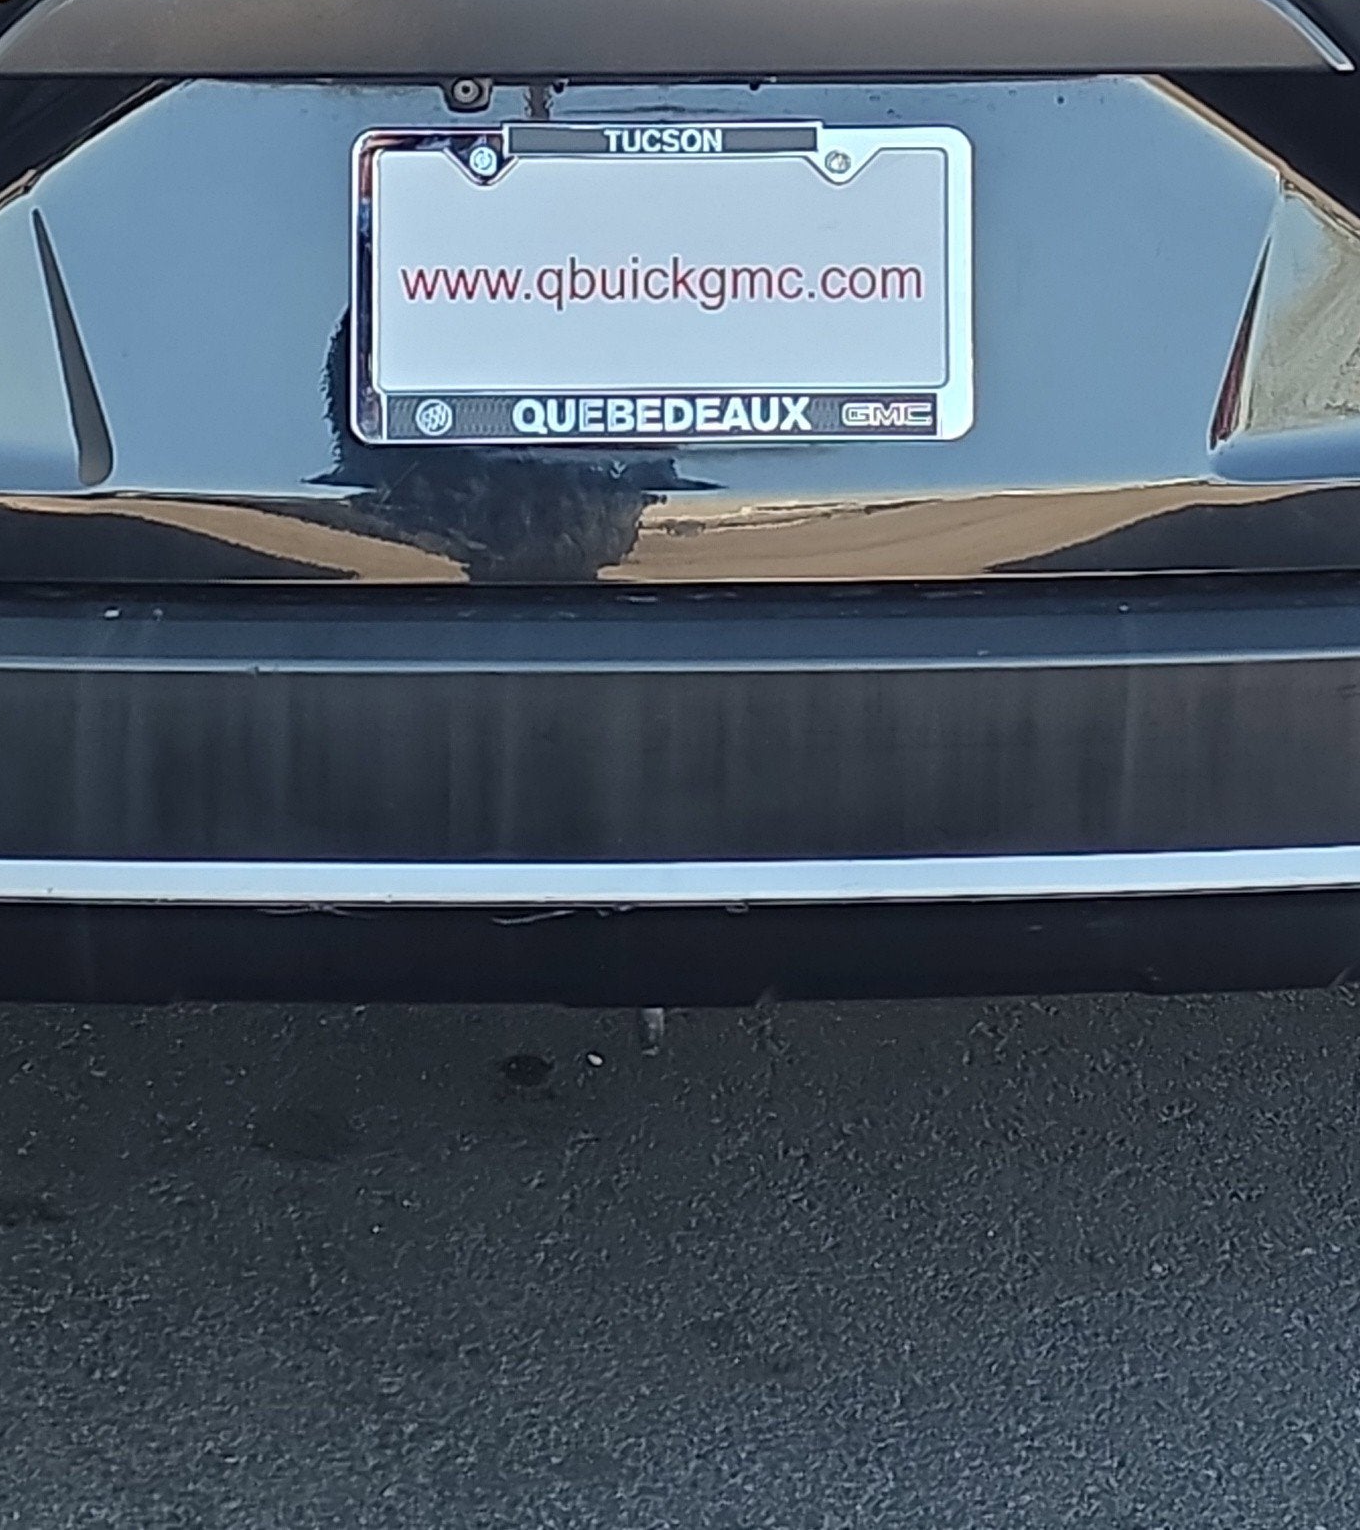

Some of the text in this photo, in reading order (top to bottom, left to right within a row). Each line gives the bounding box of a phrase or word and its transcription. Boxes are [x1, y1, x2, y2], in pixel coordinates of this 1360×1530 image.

[603, 129, 724, 154] TUCSON
[400, 255, 924, 311] www.qbuickgmc.com
[511, 396, 934, 434] QUEBEDEAUX GMC
